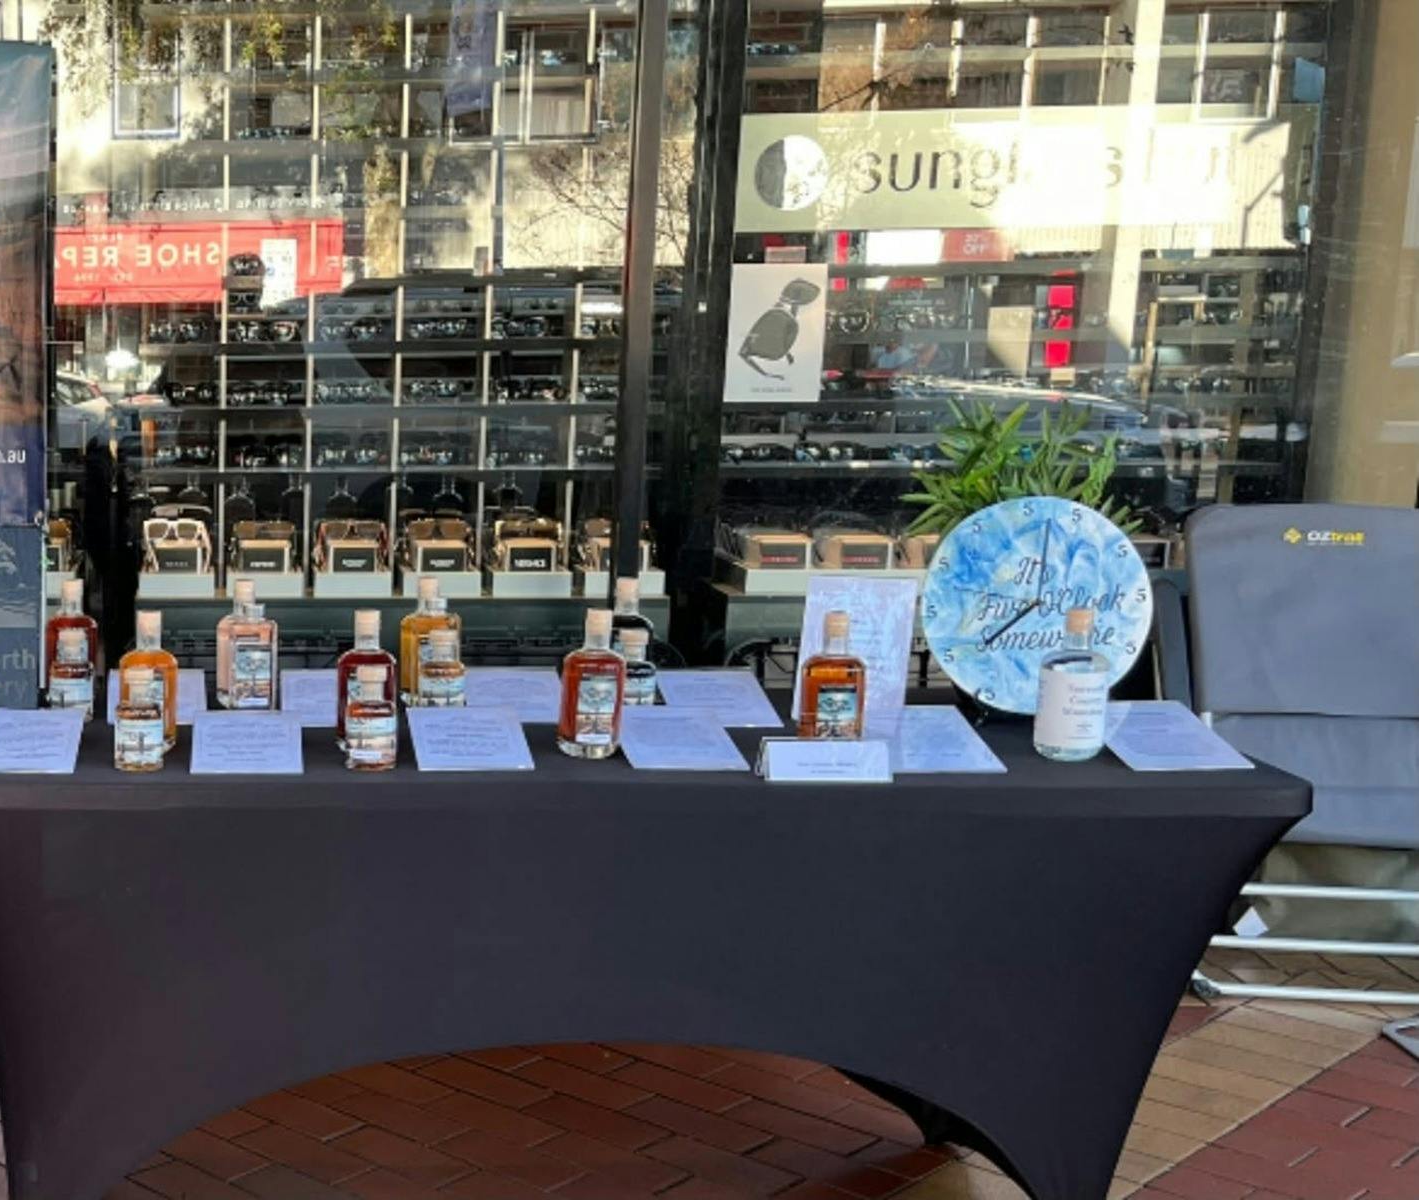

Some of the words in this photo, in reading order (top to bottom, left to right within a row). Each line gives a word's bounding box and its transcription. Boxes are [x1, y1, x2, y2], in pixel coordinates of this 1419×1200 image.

[1071, 508, 1083, 523] 5
[973, 519, 984, 533] 5
[1118, 544, 1129, 558] 5
[939, 557, 950, 571] 5
[1135, 588, 1147, 602] 5
[926, 605, 938, 620] 5
[944, 649, 955, 663] 5
